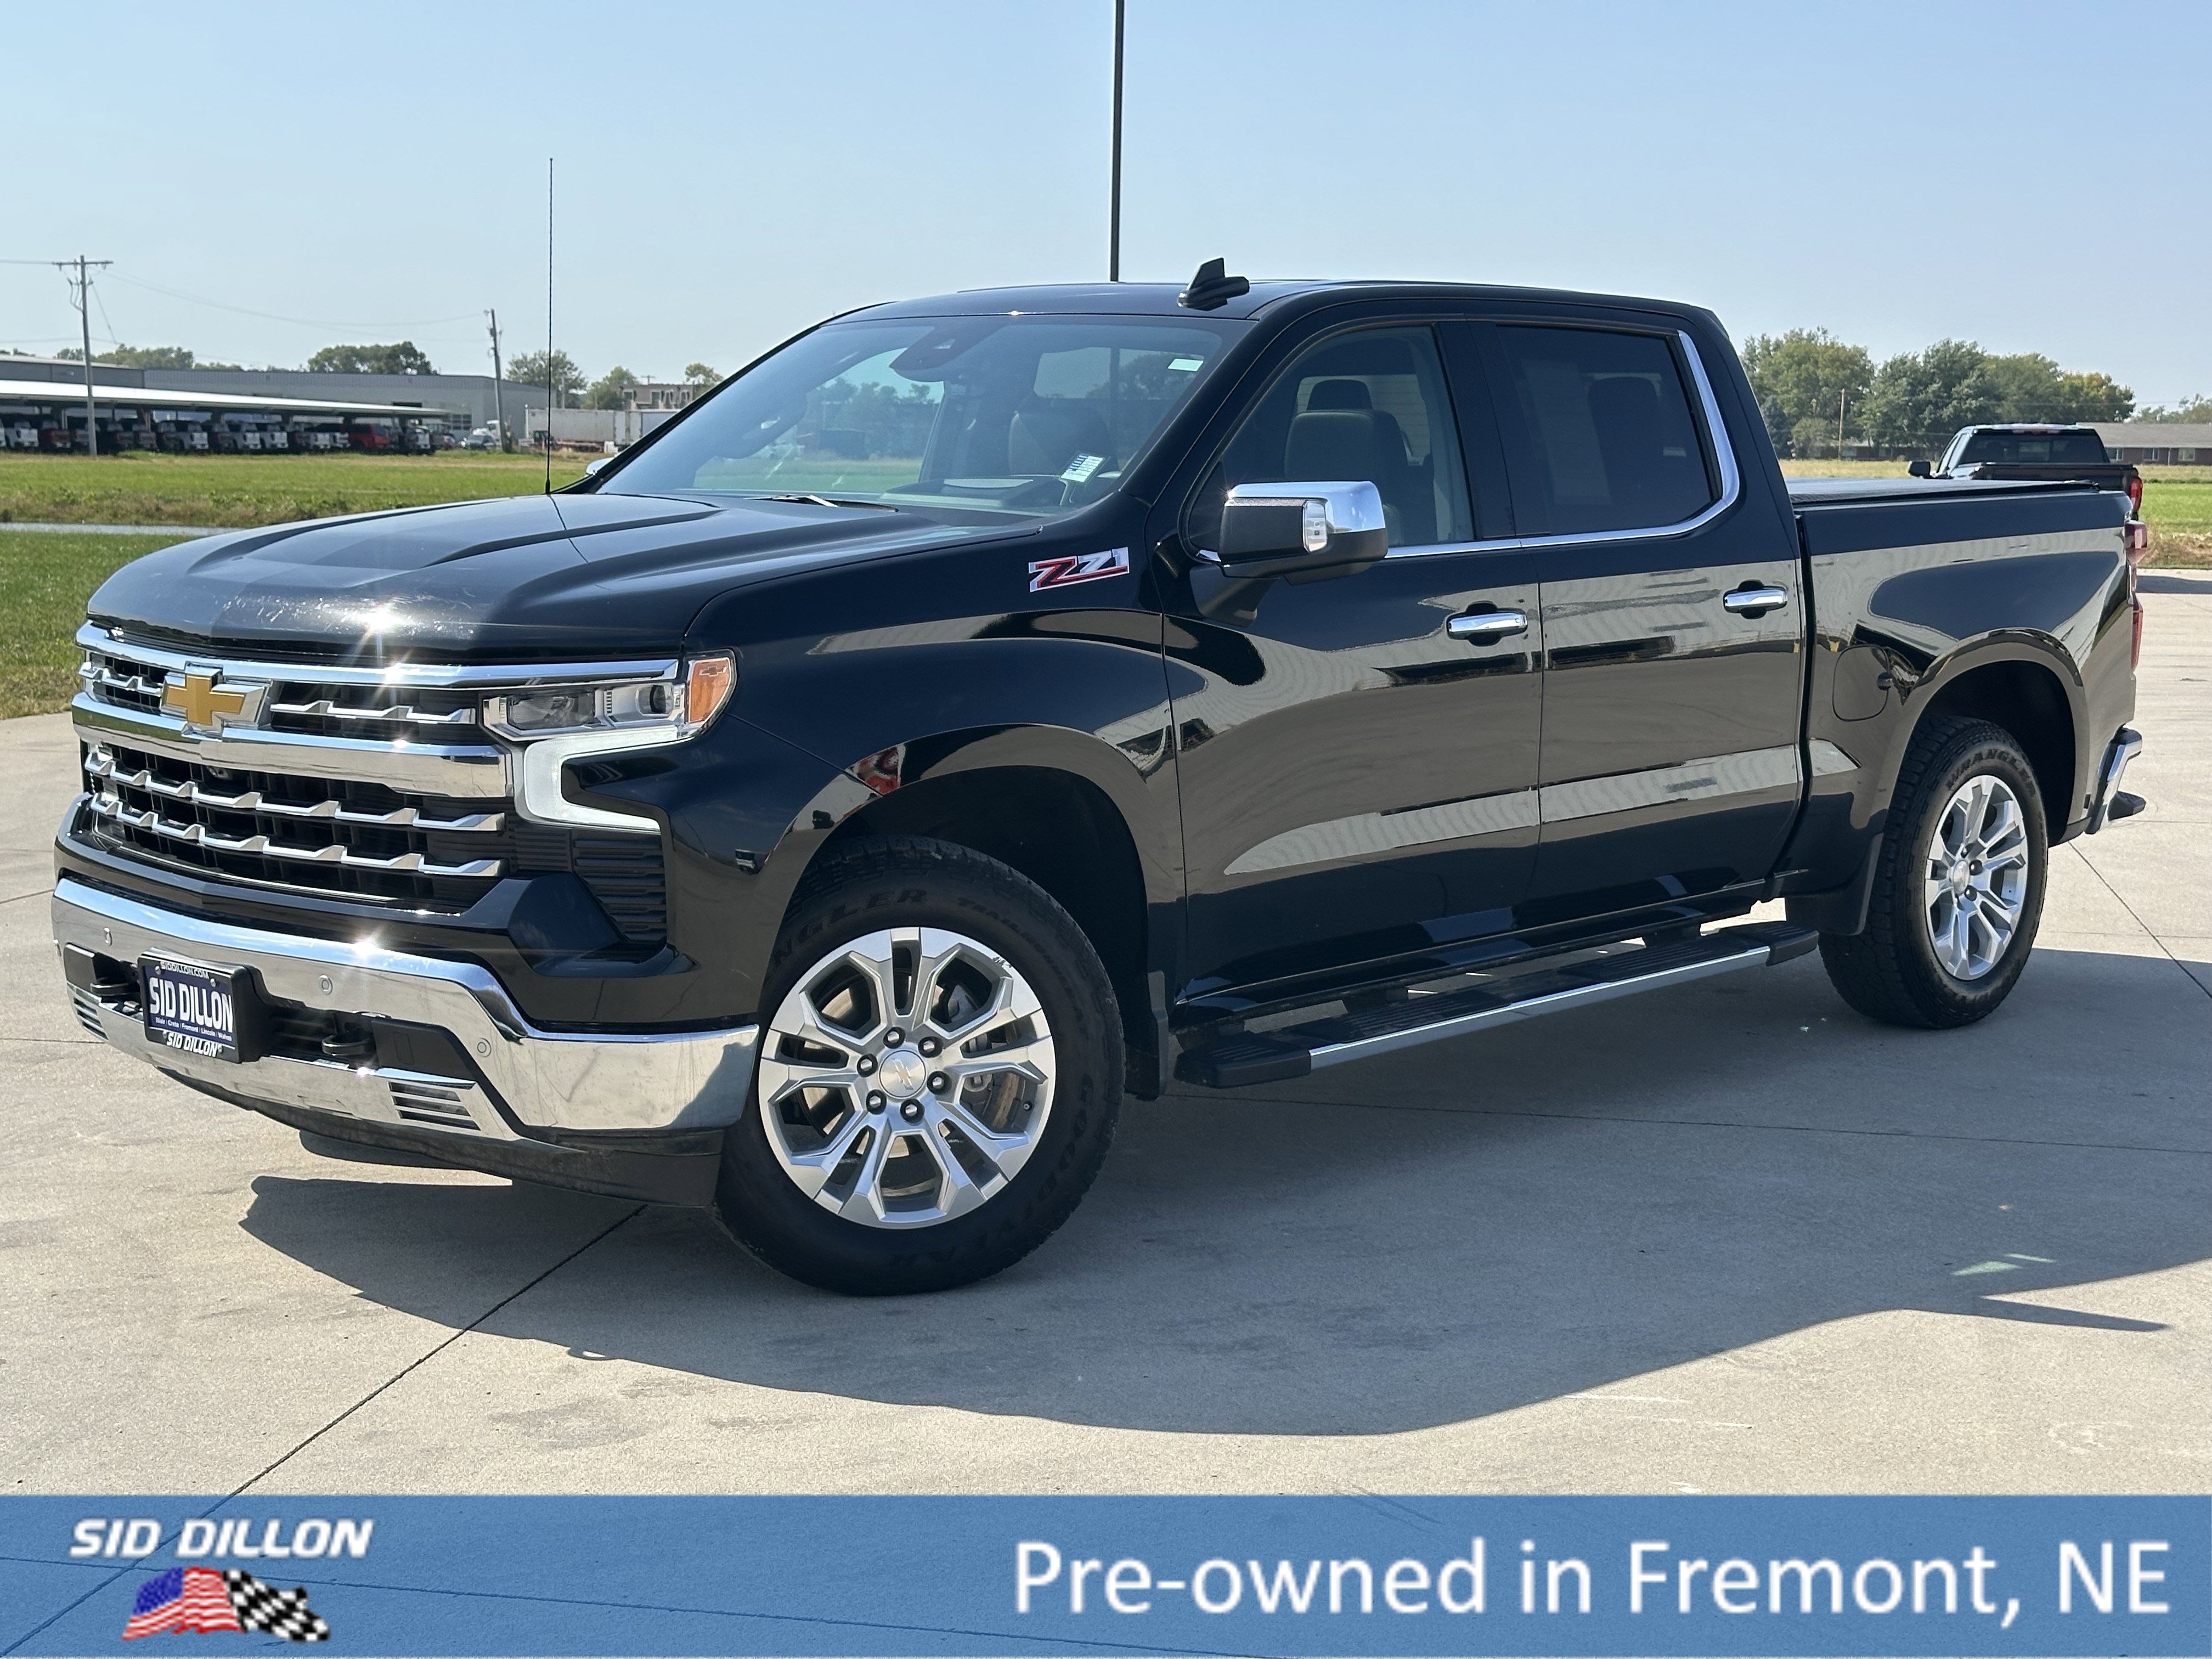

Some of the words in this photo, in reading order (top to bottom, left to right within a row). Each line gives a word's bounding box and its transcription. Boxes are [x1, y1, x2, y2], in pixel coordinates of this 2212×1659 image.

[1028, 546, 1130, 592] Z71
[1945, 748, 2036, 795] WRANGLER
[149, 977, 176, 1018] SID
[178, 983, 233, 1033] DILLON
[167, 1032, 183, 1048] SID
[183, 1036, 219, 1057] DILLON
